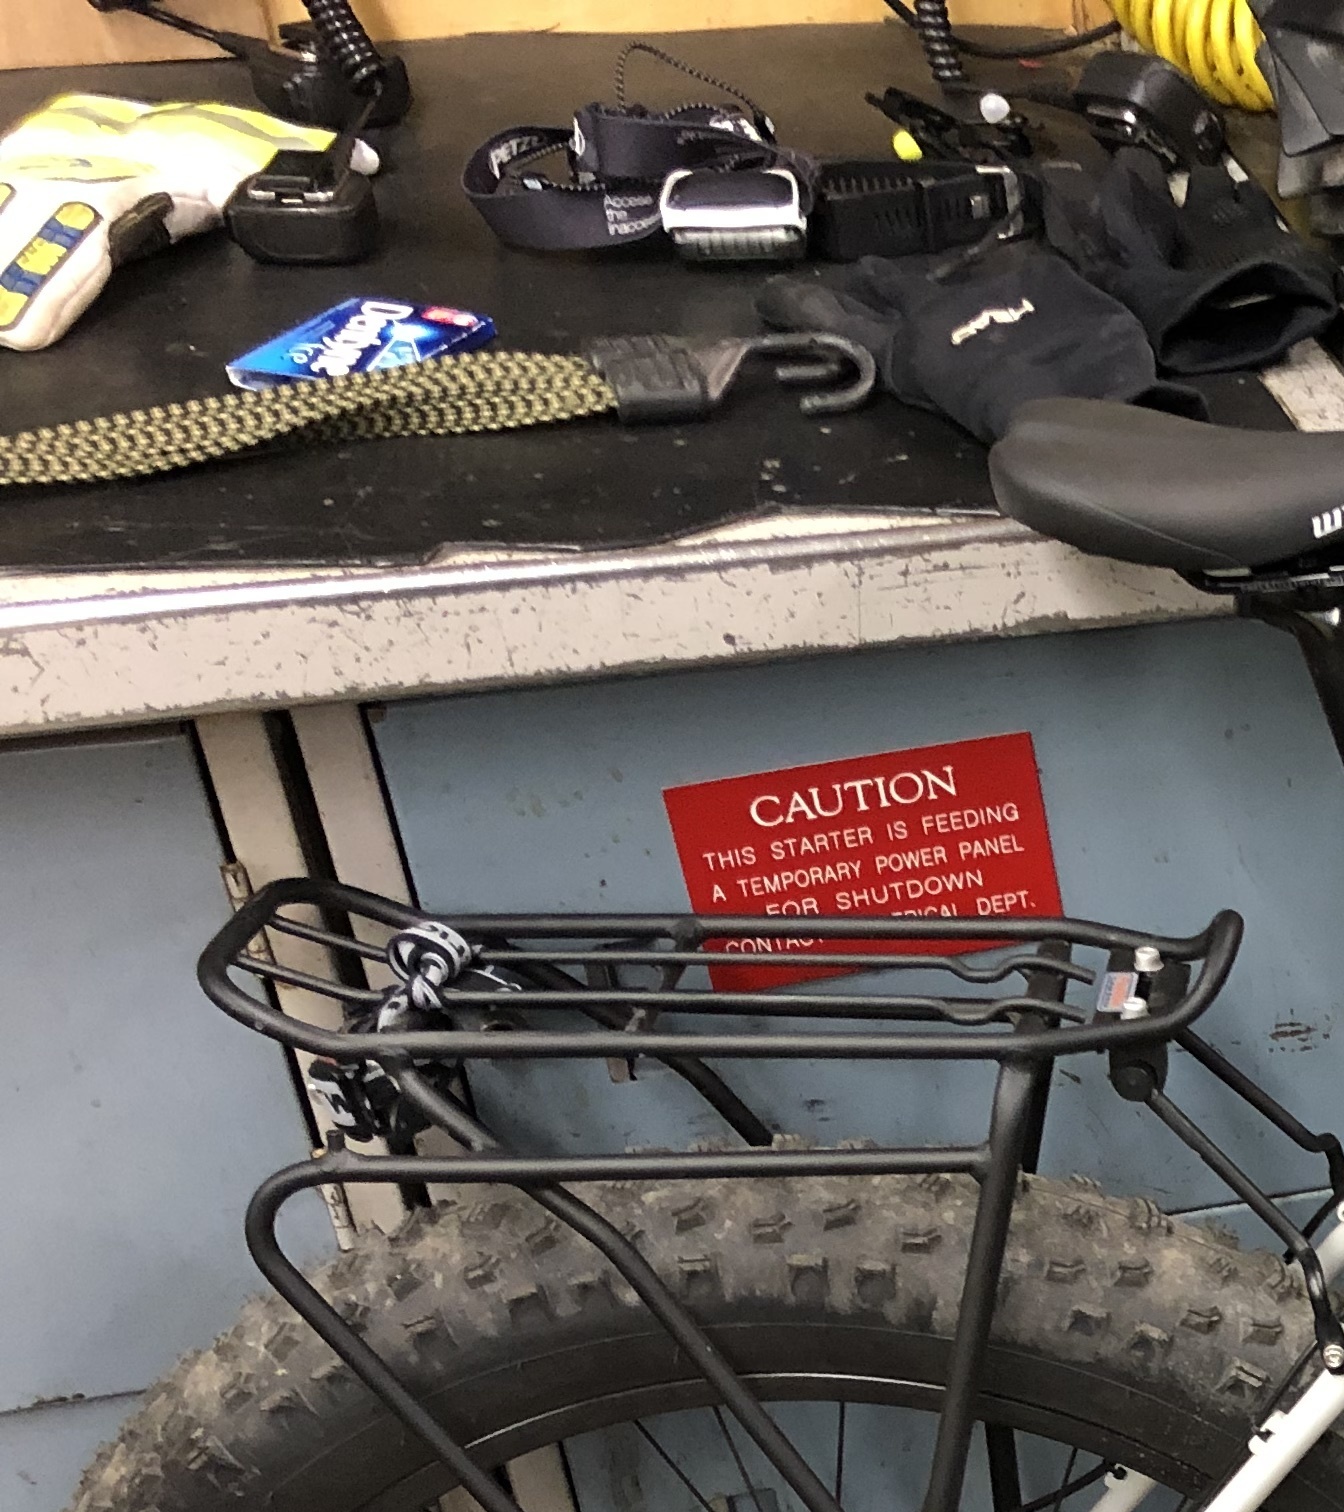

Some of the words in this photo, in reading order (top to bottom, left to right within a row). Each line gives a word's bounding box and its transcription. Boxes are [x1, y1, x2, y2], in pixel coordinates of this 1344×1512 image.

[750, 765, 957, 827] CAUTION
[703, 847, 756, 871] THIS
[770, 826, 873, 860] STARTER
[887, 821, 908, 841] IS
[922, 803, 1019, 834] FEEDING
[712, 884, 727, 902] A
[737, 860, 862, 898] TEMPORARY
[876, 847, 948, 875] POWER
[959, 834, 1025, 864] PANEL
[765, 898, 820, 916] FOR
[836, 869, 984, 911] SHUTDOWN
[977, 889, 1036, 915] DEPT.
